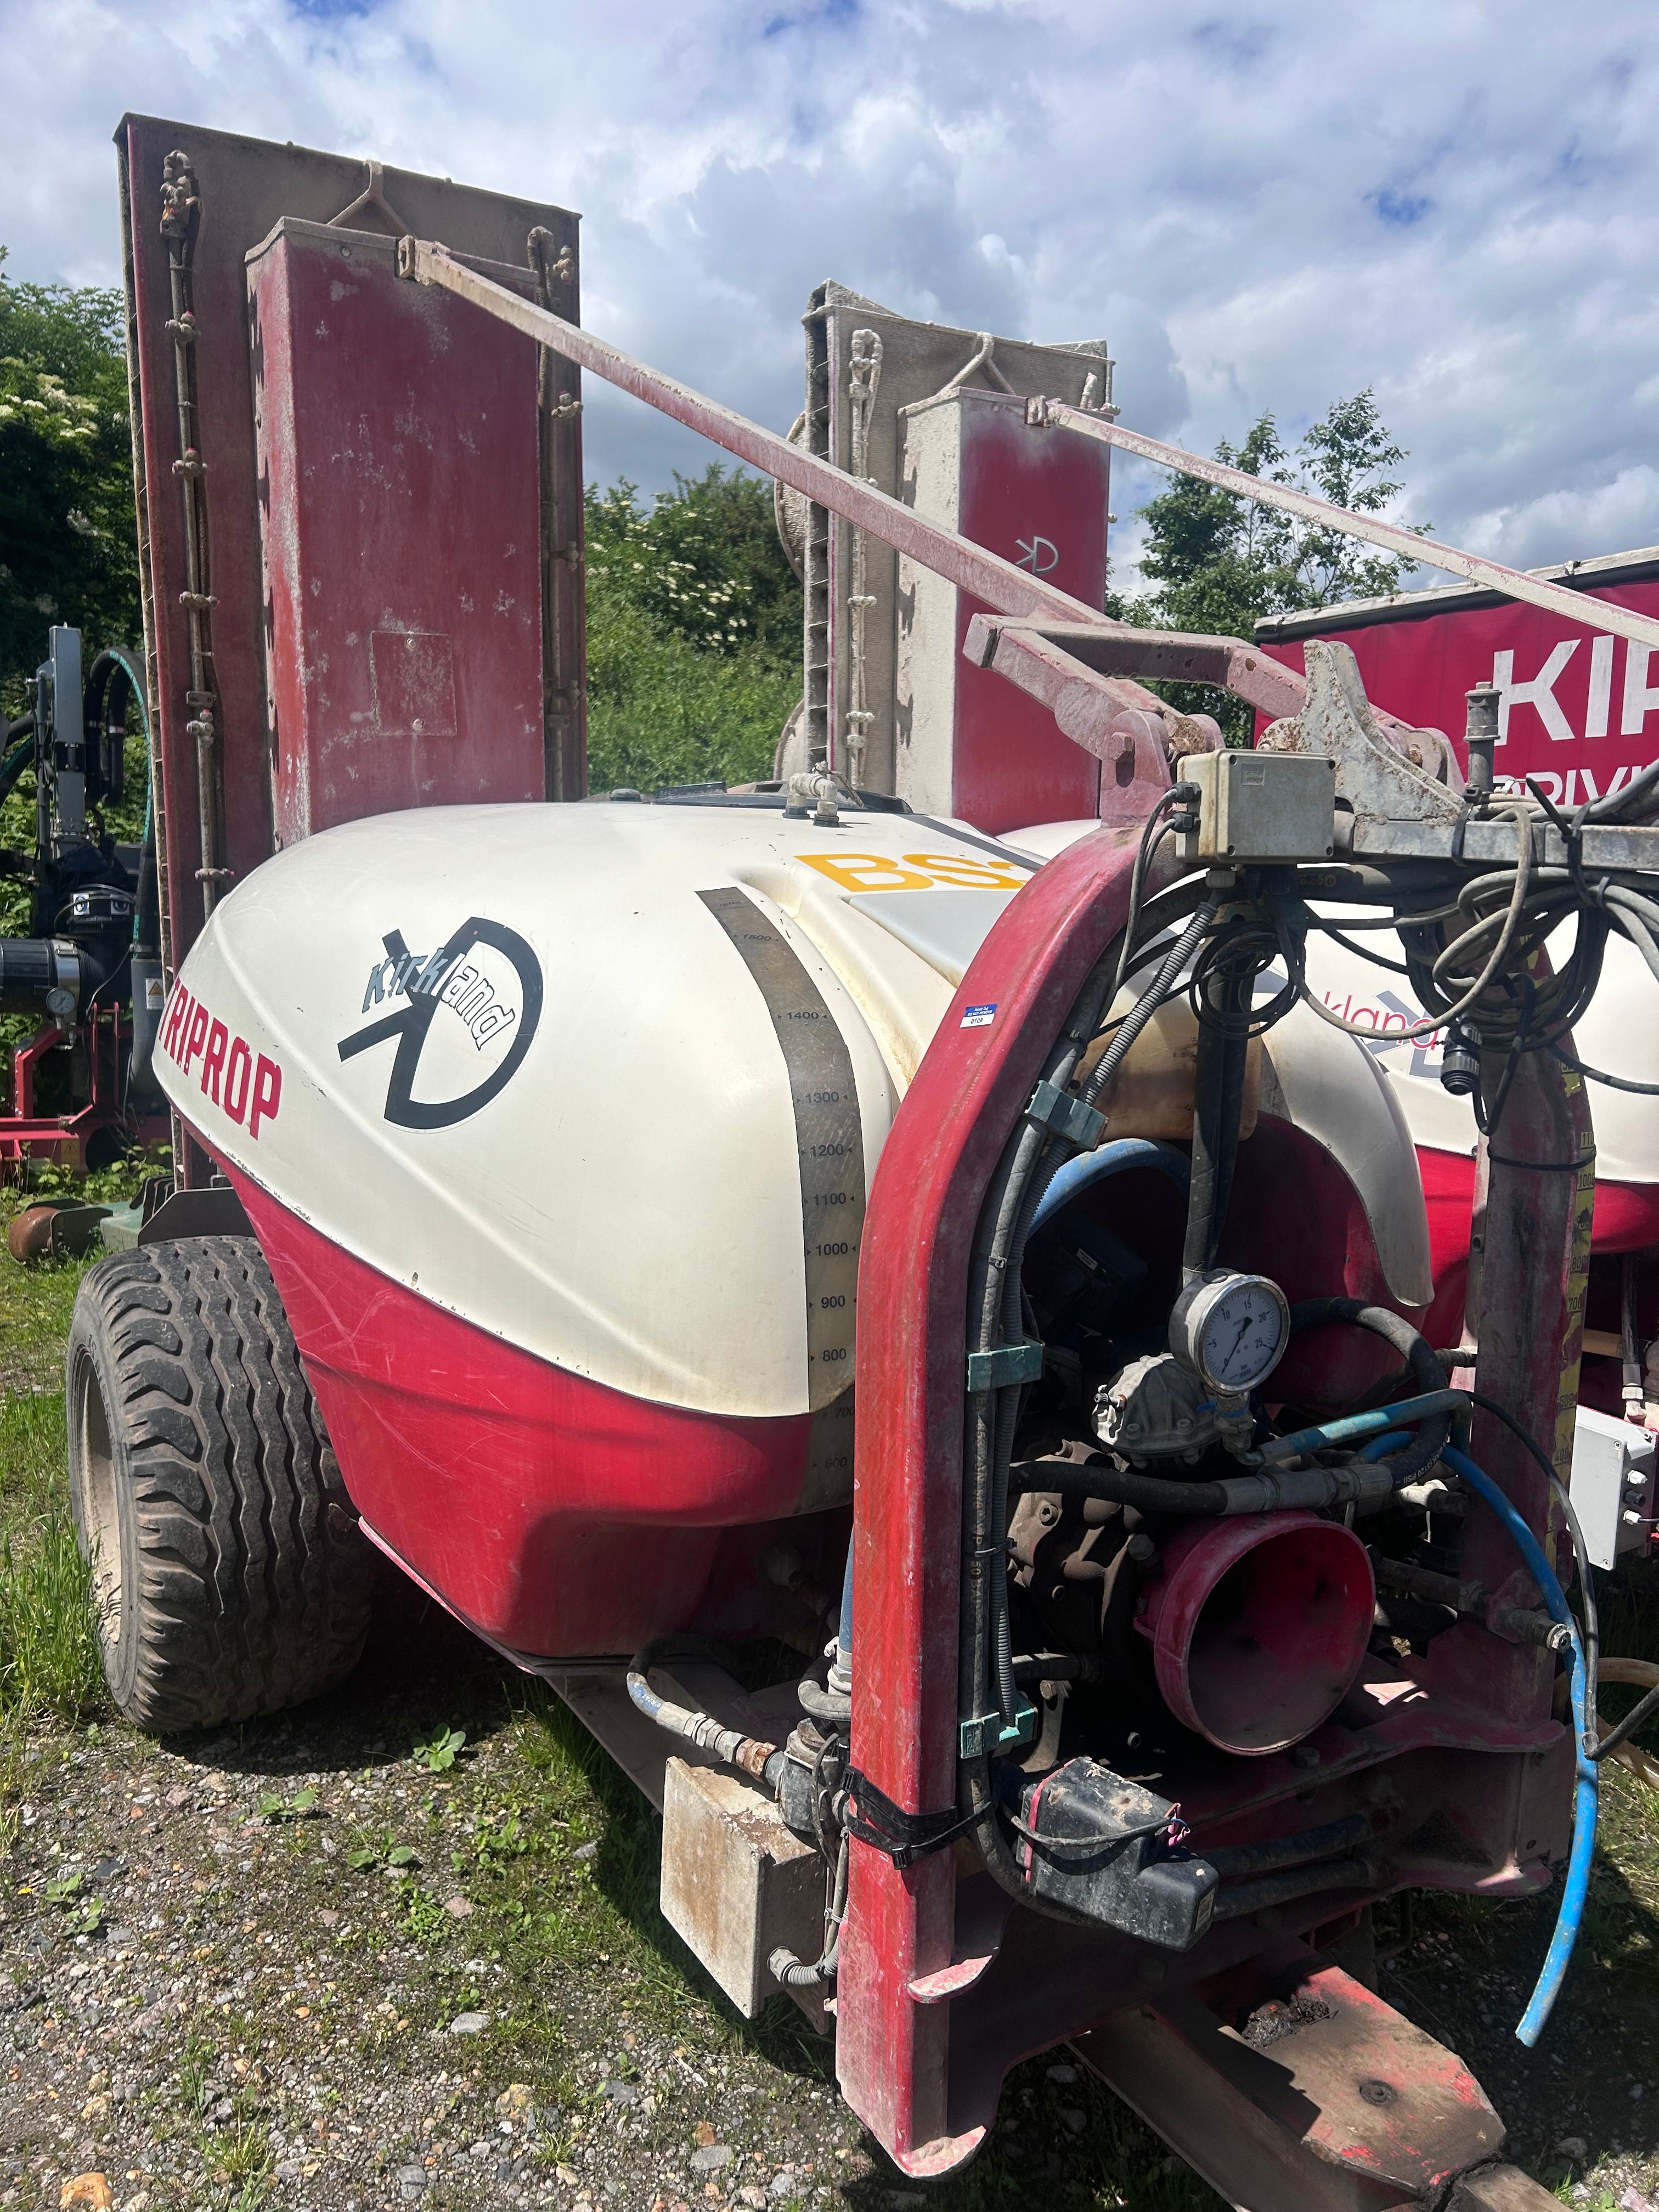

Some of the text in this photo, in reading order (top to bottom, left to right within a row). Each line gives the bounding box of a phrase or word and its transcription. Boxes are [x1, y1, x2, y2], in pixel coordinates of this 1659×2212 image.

[362, 947, 516, 1051] Kirkland
[786, 1012, 819, 1020] 1400
[159, 976, 282, 1141] TRIPROP
[805, 1091, 840, 1104] 1300
[809, 1144, 845, 1157] 1200
[812, 1192, 847, 1205] 1100
[815, 1243, 849, 1256] 1000
[821, 1295, 846, 1309] 900
[1244, 1298, 1252, 1310] 15
[1223, 1310, 1231, 1321] 10
[1259, 1311, 1267, 1323] 20
[1212, 1339, 1217, 1348] 5
[1255, 1337, 1263, 1348] 25
[823, 1348, 847, 1362] 800
[1224, 1358, 1228, 1367] 0
[825, 1456, 848, 1470] 600
